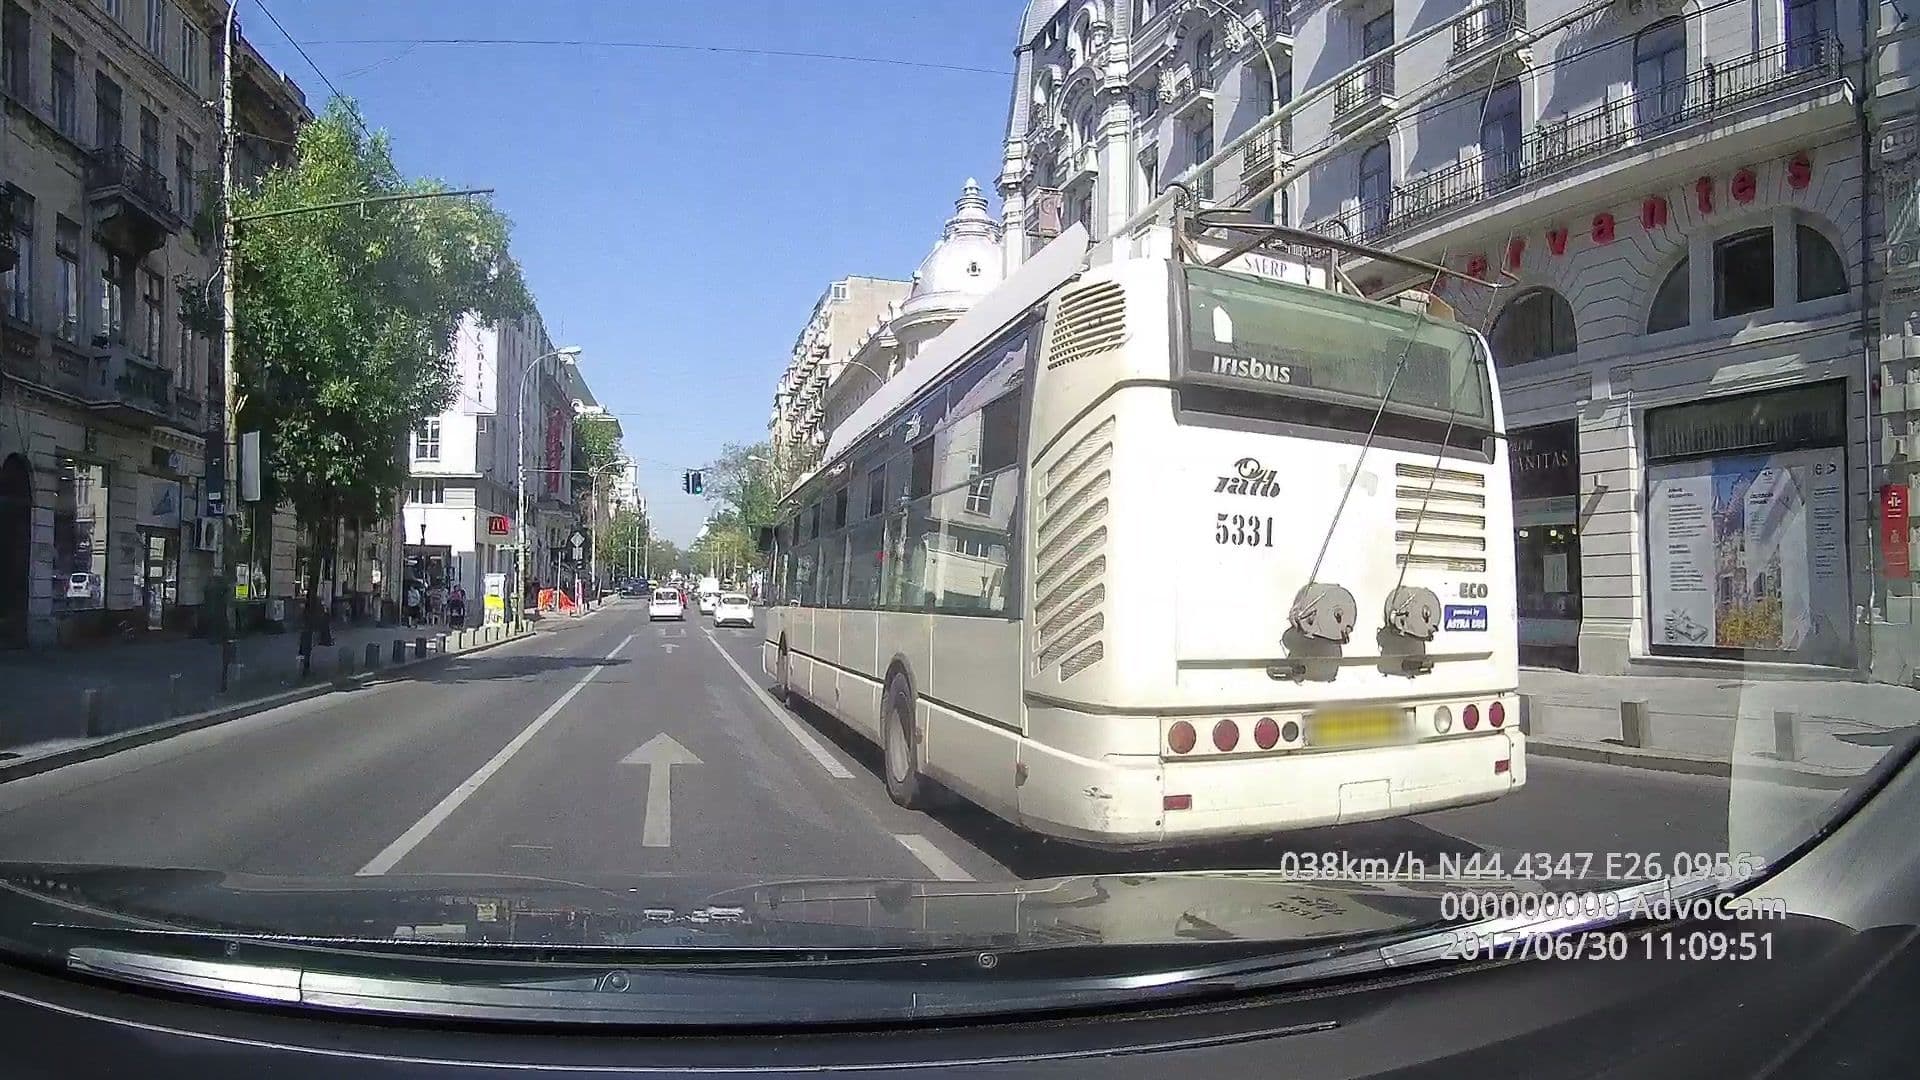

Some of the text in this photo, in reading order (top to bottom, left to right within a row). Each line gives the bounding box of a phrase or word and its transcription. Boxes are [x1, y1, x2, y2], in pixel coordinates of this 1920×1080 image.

[1510, 450, 1568, 473] ANITAS
[1216, 513, 1274, 547] 5331
[1459, 583, 1488, 599] ECO
